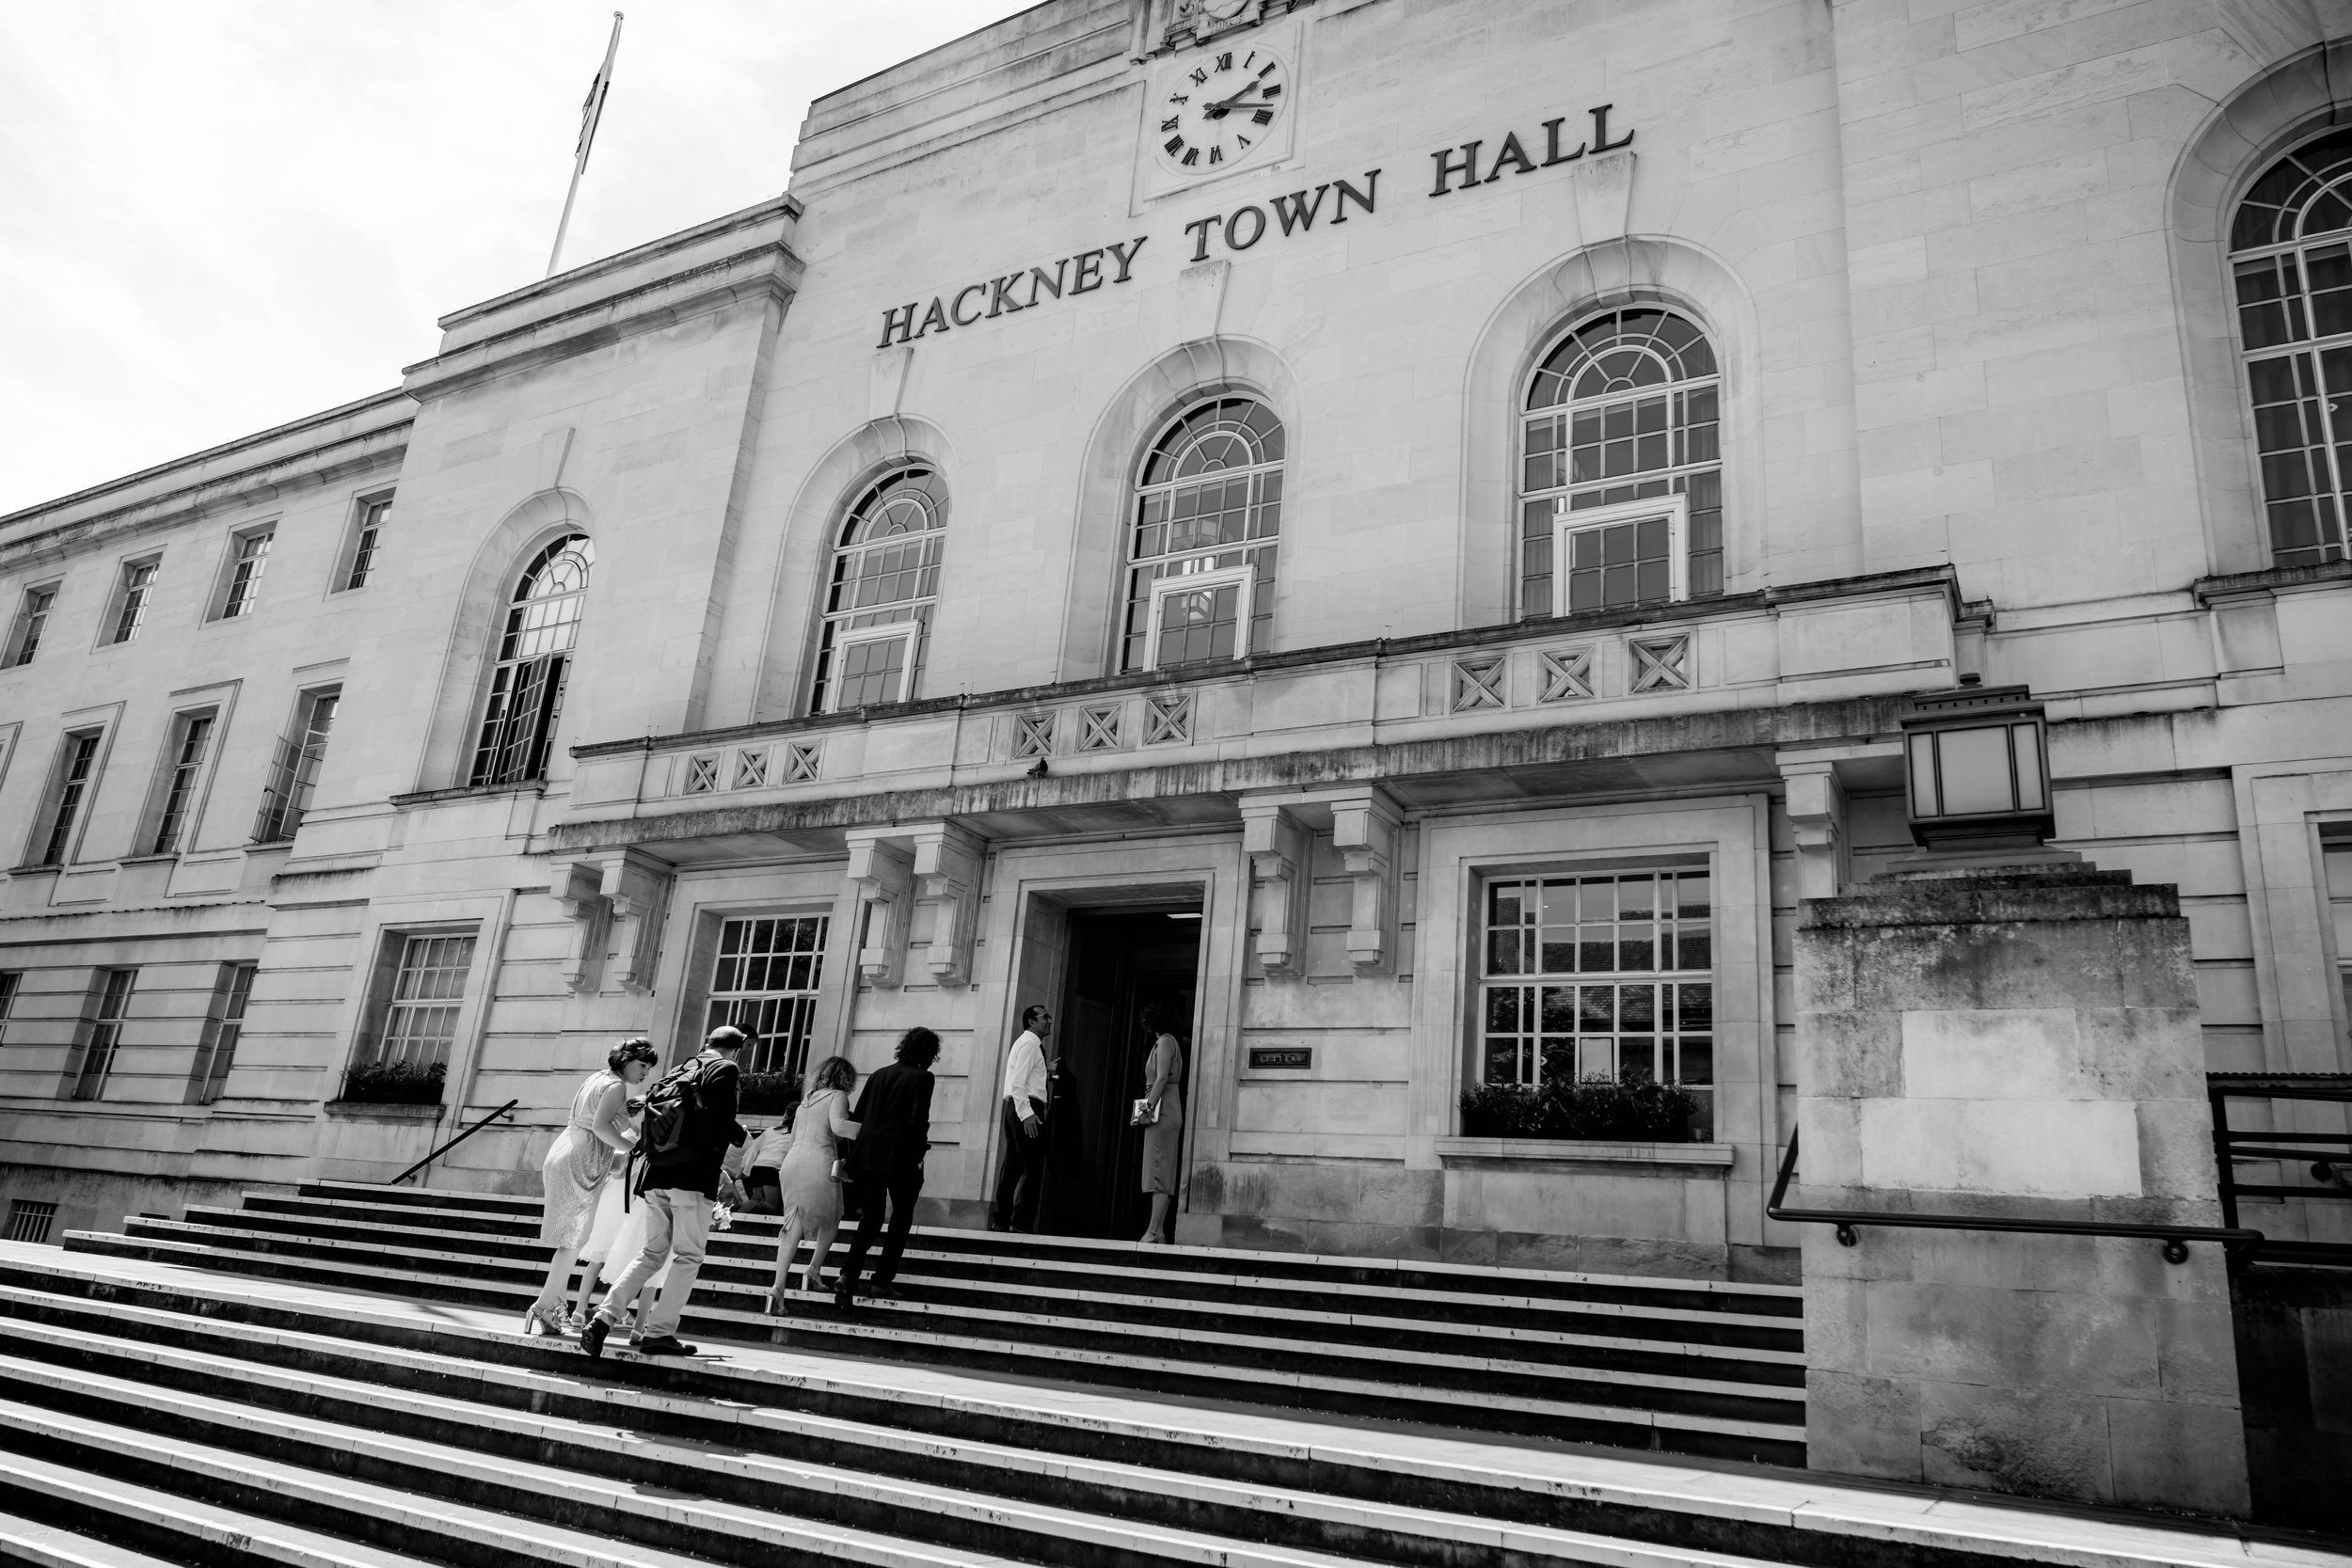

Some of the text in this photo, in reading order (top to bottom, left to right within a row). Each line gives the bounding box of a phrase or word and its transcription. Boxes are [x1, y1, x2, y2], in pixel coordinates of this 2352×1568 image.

[1215, 52, 1232, 73] XII
[1243, 51, 1256, 69] I
[1189, 68, 1209, 87] XI
[1258, 61, 1277, 79] II
[1169, 93, 1189, 105] X
[1237, 135, 1251, 150] V
[1209, 145, 1223, 164] VI
[876, 103, 1635, 349] HACKNEY TOWN HALL
